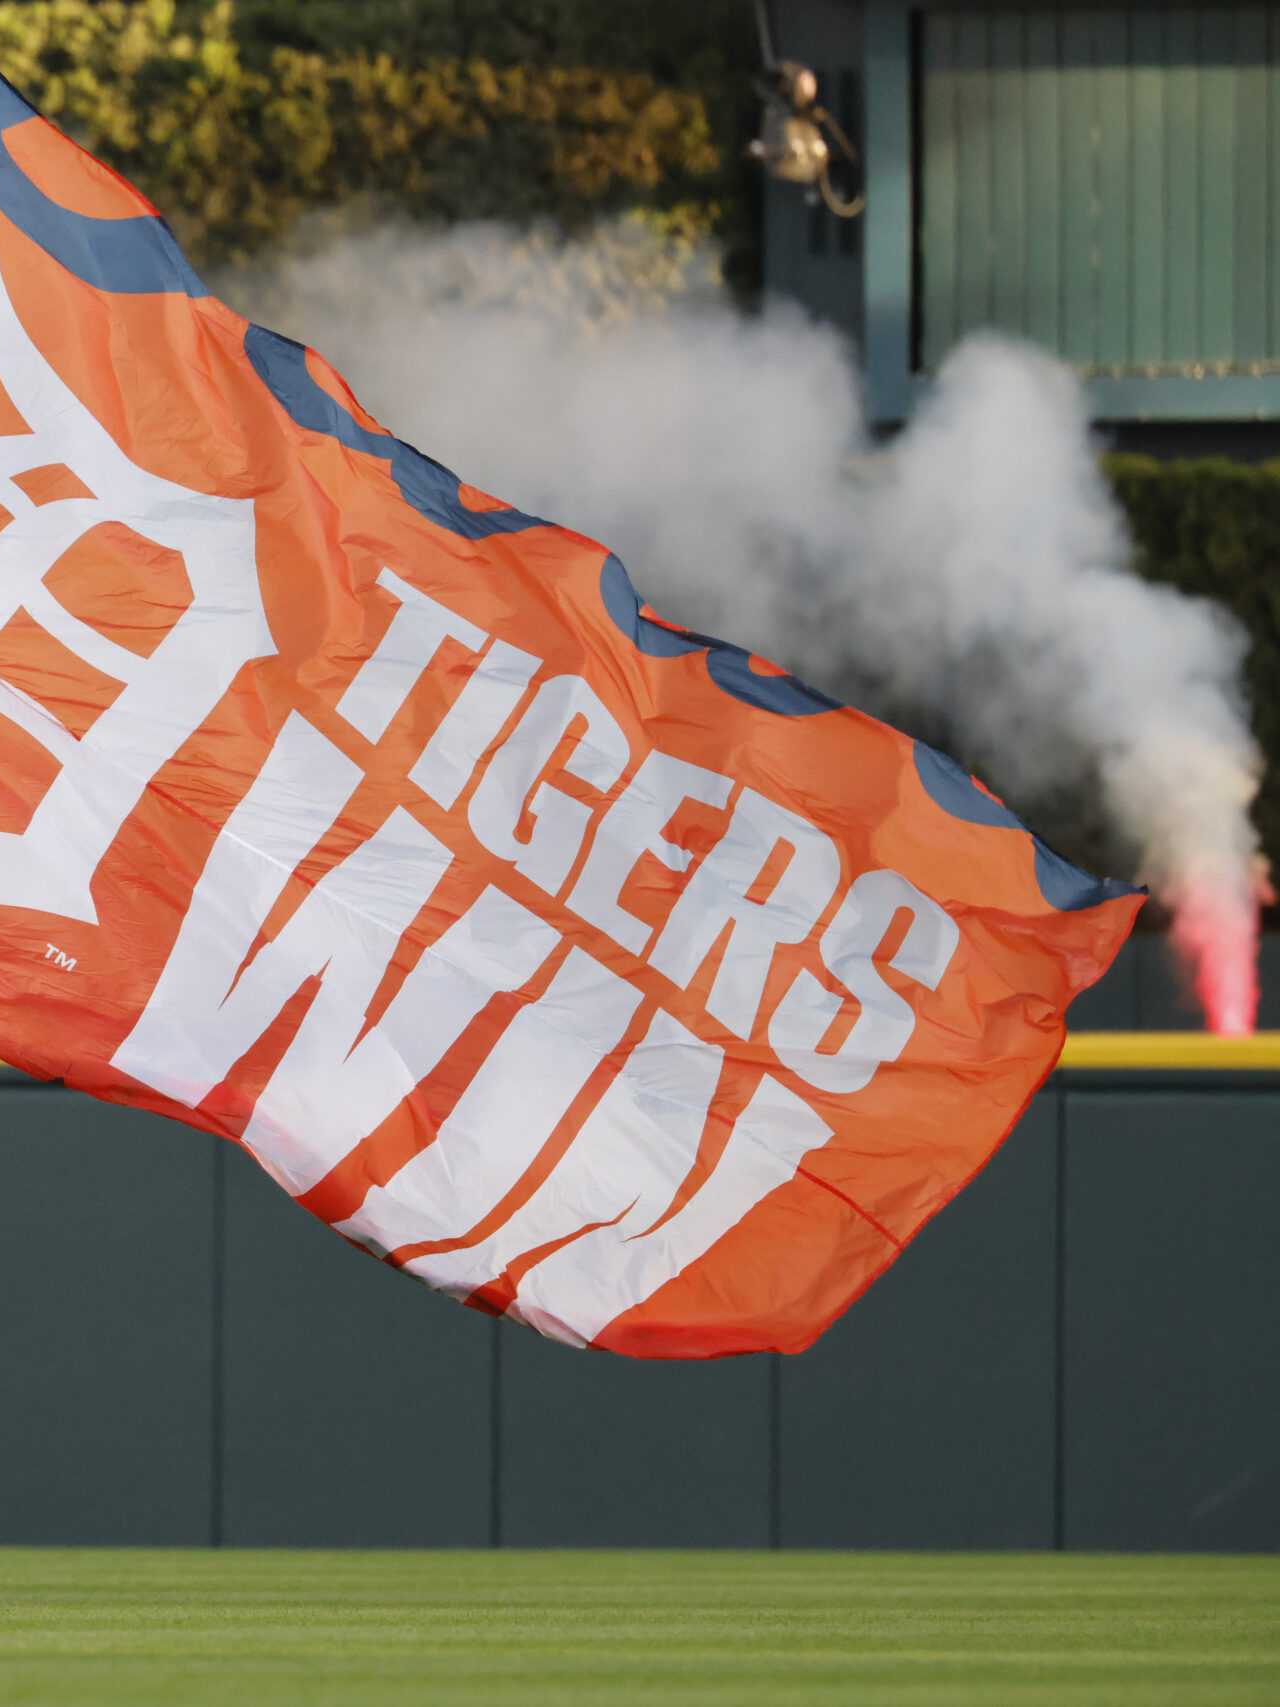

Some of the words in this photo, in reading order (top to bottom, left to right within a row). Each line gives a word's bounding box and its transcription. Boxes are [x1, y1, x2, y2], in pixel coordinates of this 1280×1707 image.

[44, 942, 78, 972] TM
[108, 708, 836, 1349] WIN
[334, 566, 960, 1094] TIGERS
